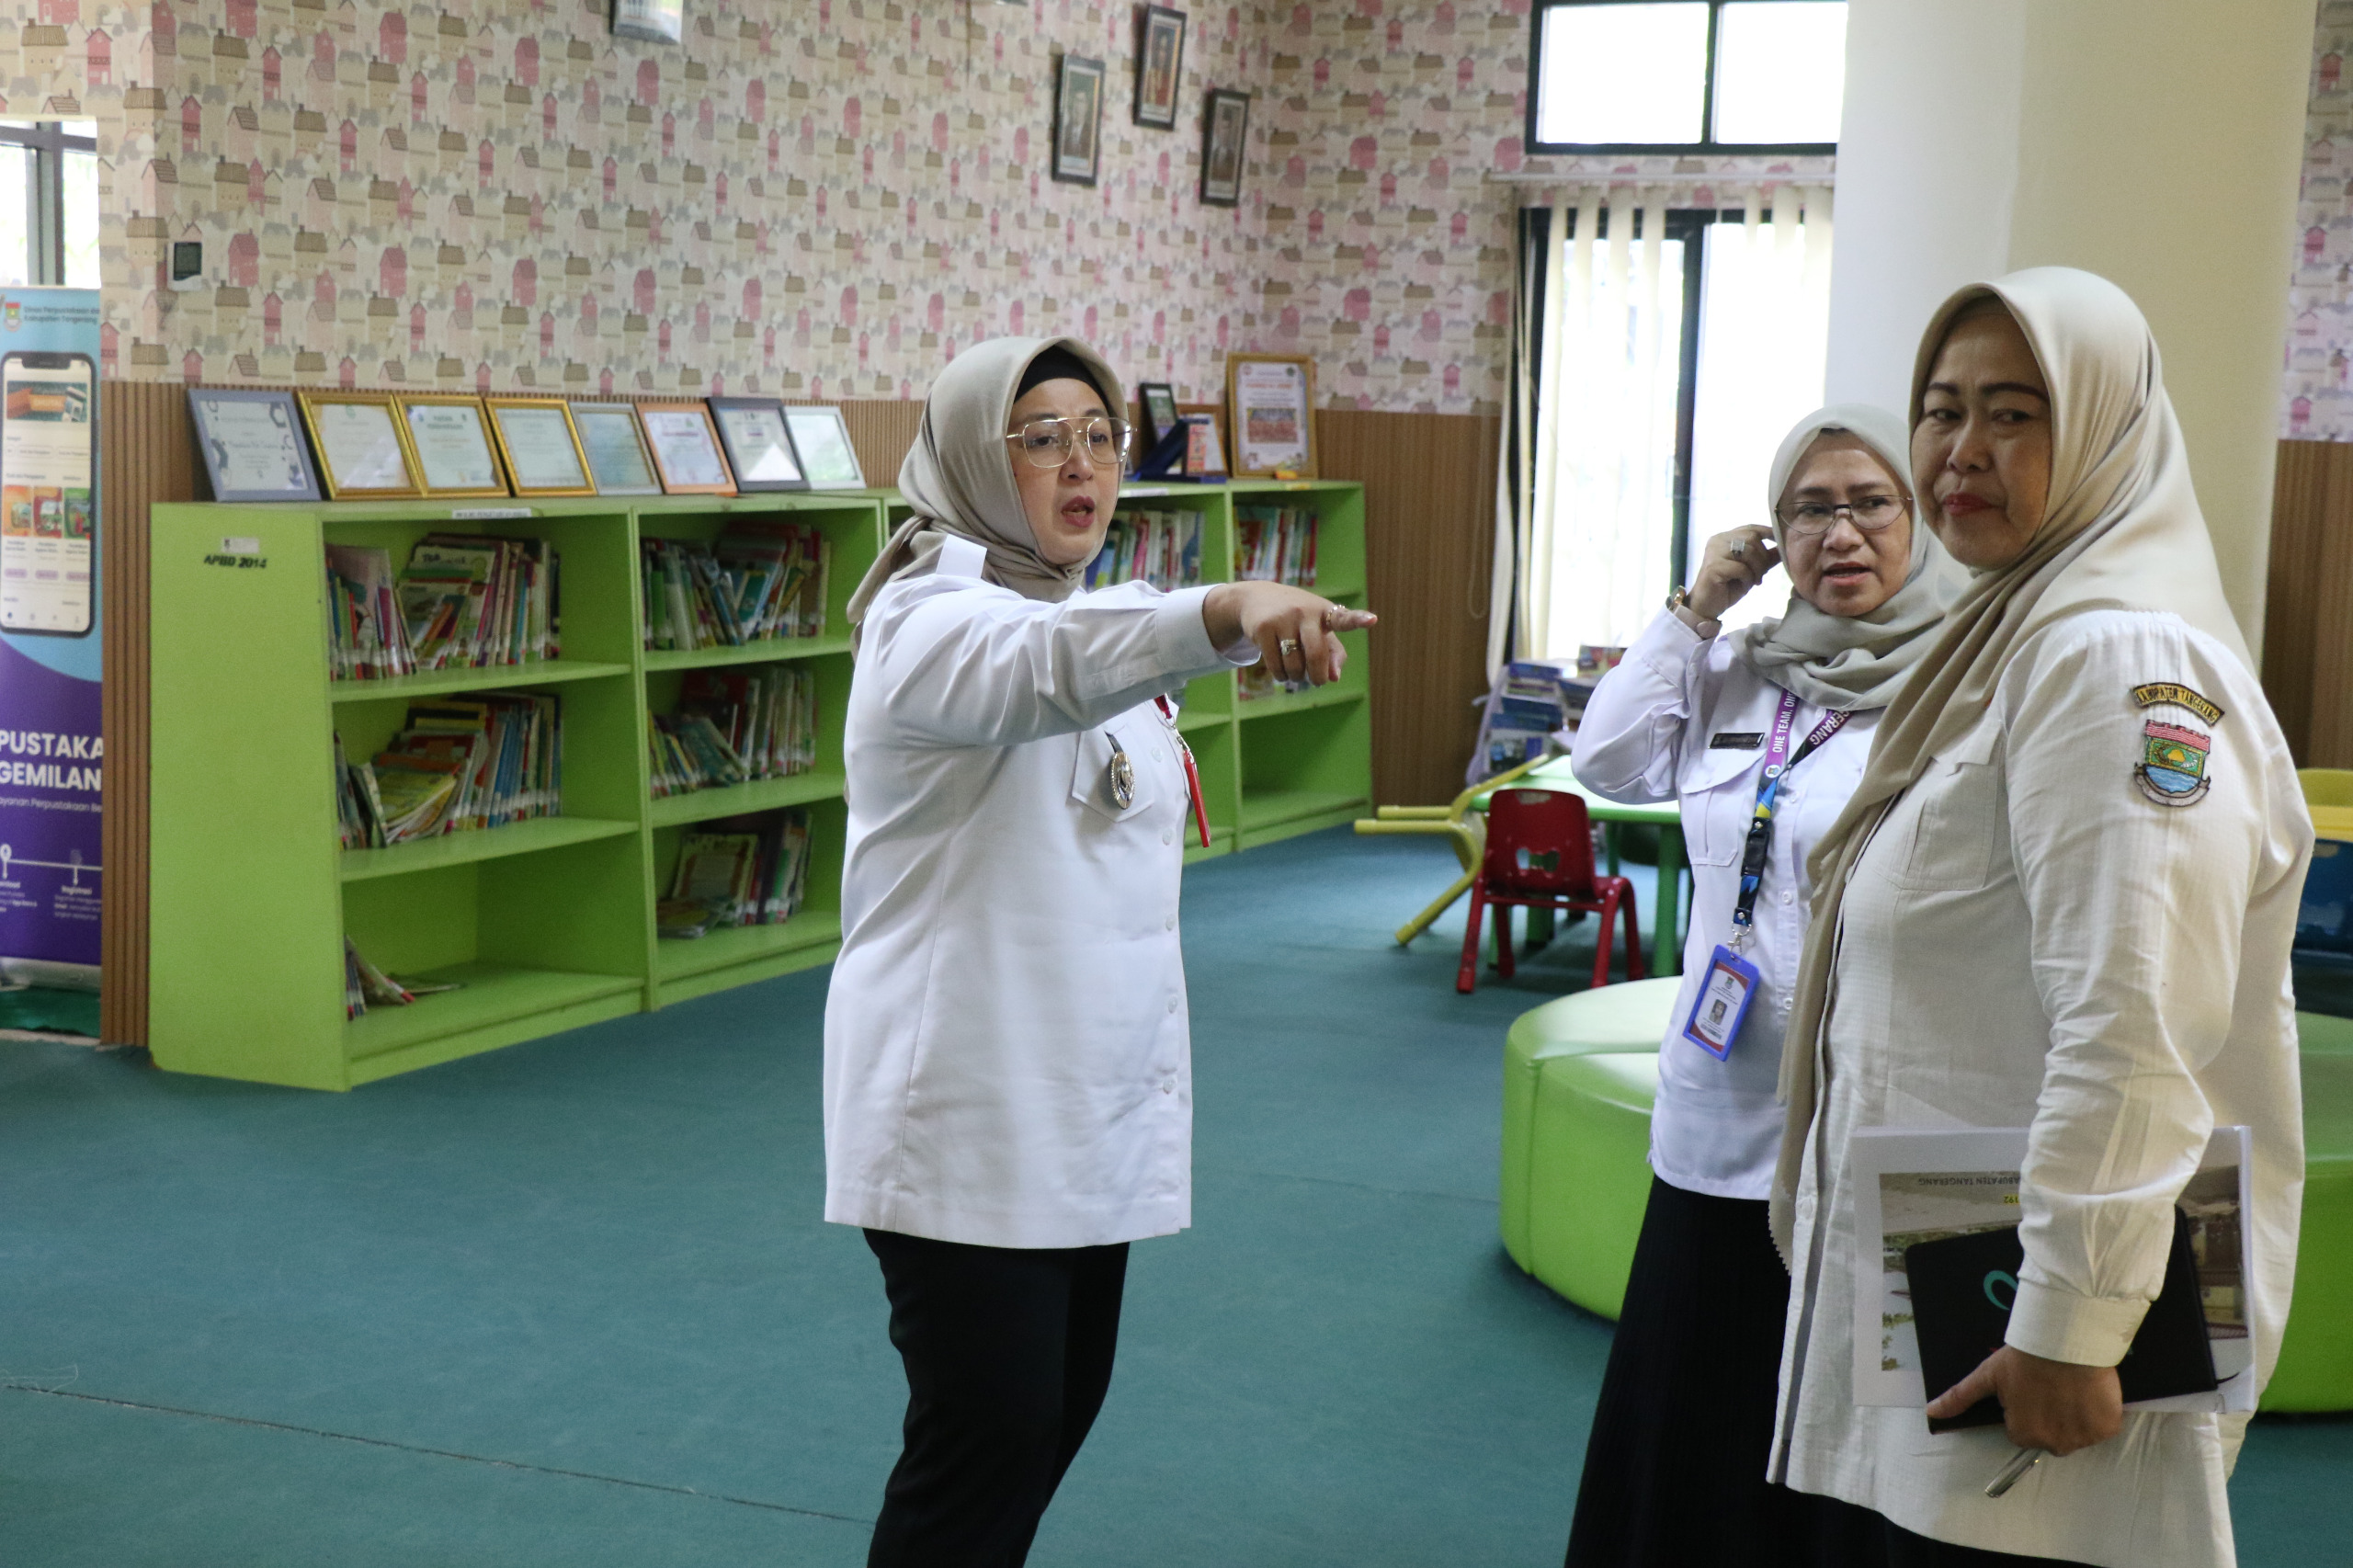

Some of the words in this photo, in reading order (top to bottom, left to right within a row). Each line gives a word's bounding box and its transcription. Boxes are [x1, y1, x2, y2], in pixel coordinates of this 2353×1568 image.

[1777, 710, 1793, 736] TEAM.
[1772, 735, 1785, 753] ONE
[0, 760, 102, 791] GEMILAN
[1918, 1177, 1974, 1186] TANGERANG
[2003, 1196, 2019, 1204] 192
